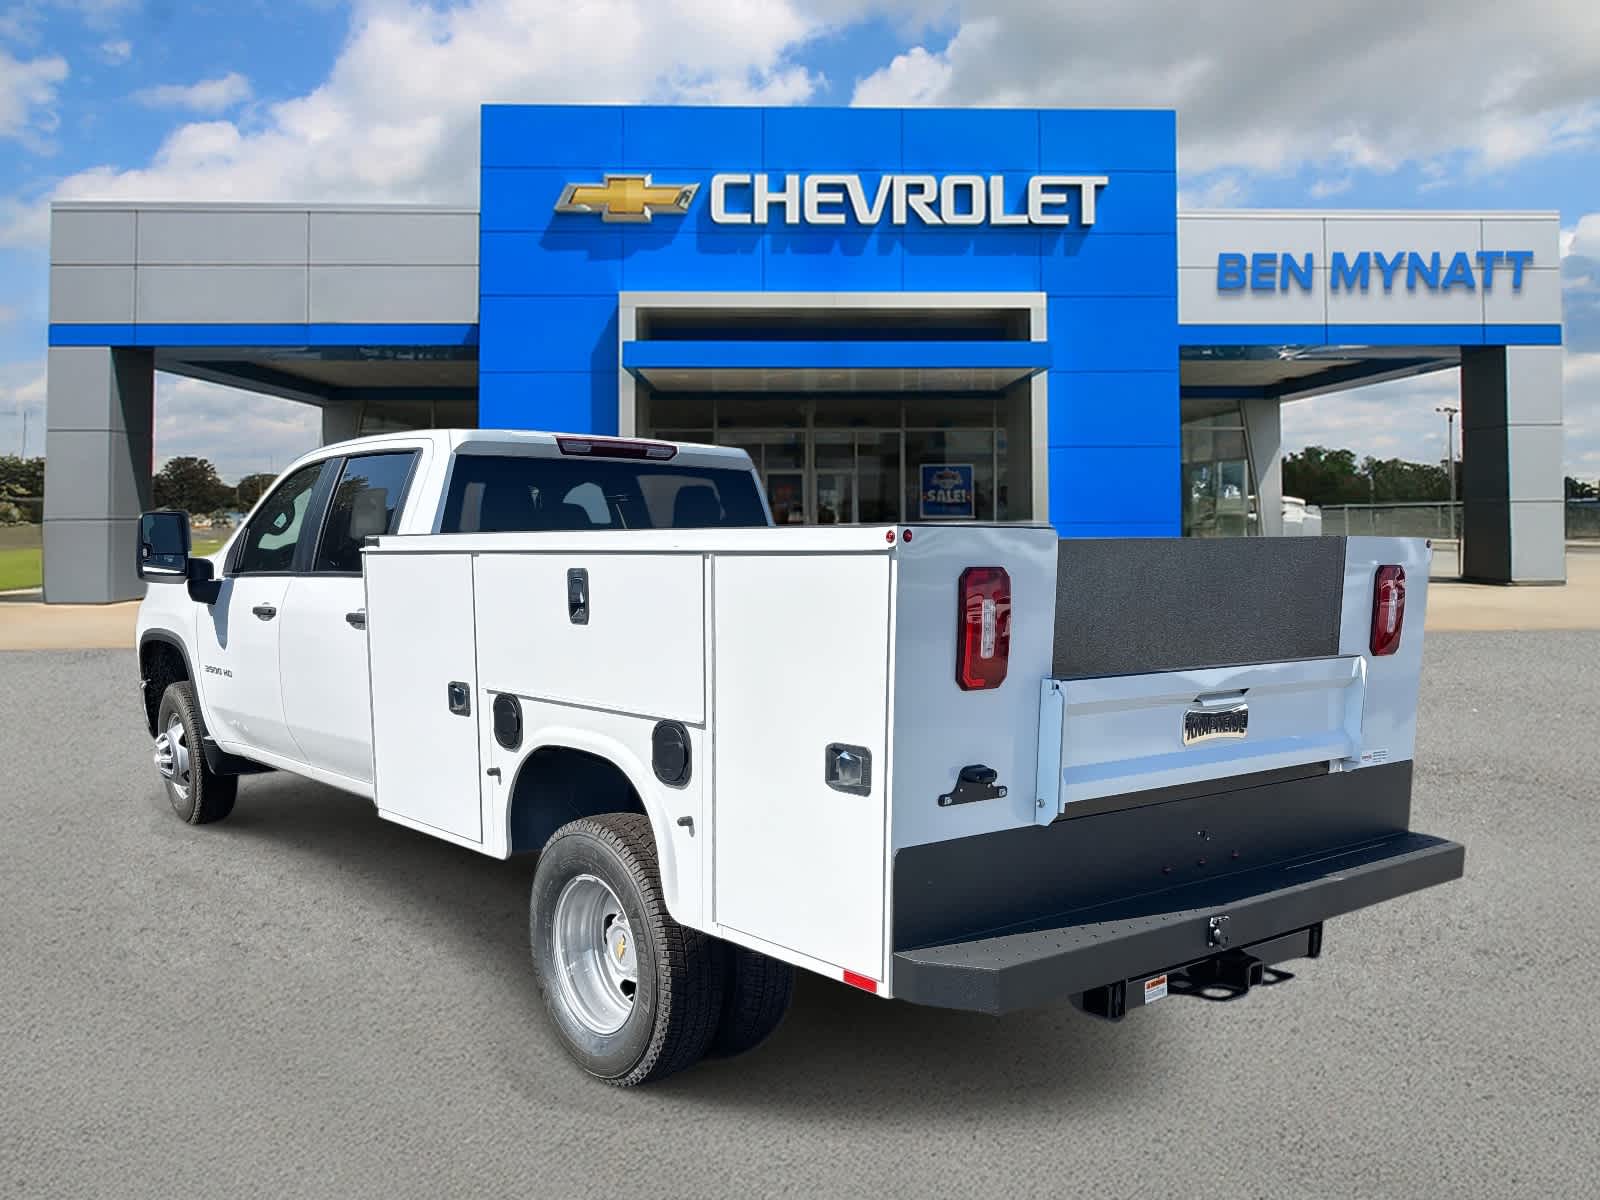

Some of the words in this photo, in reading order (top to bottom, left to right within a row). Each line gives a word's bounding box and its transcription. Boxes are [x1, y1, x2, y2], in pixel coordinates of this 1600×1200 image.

[711, 173, 1109, 225] CHEVROLET
[1217, 252, 1314, 290] BEN
[1330, 250, 1534, 290] MYNATT
